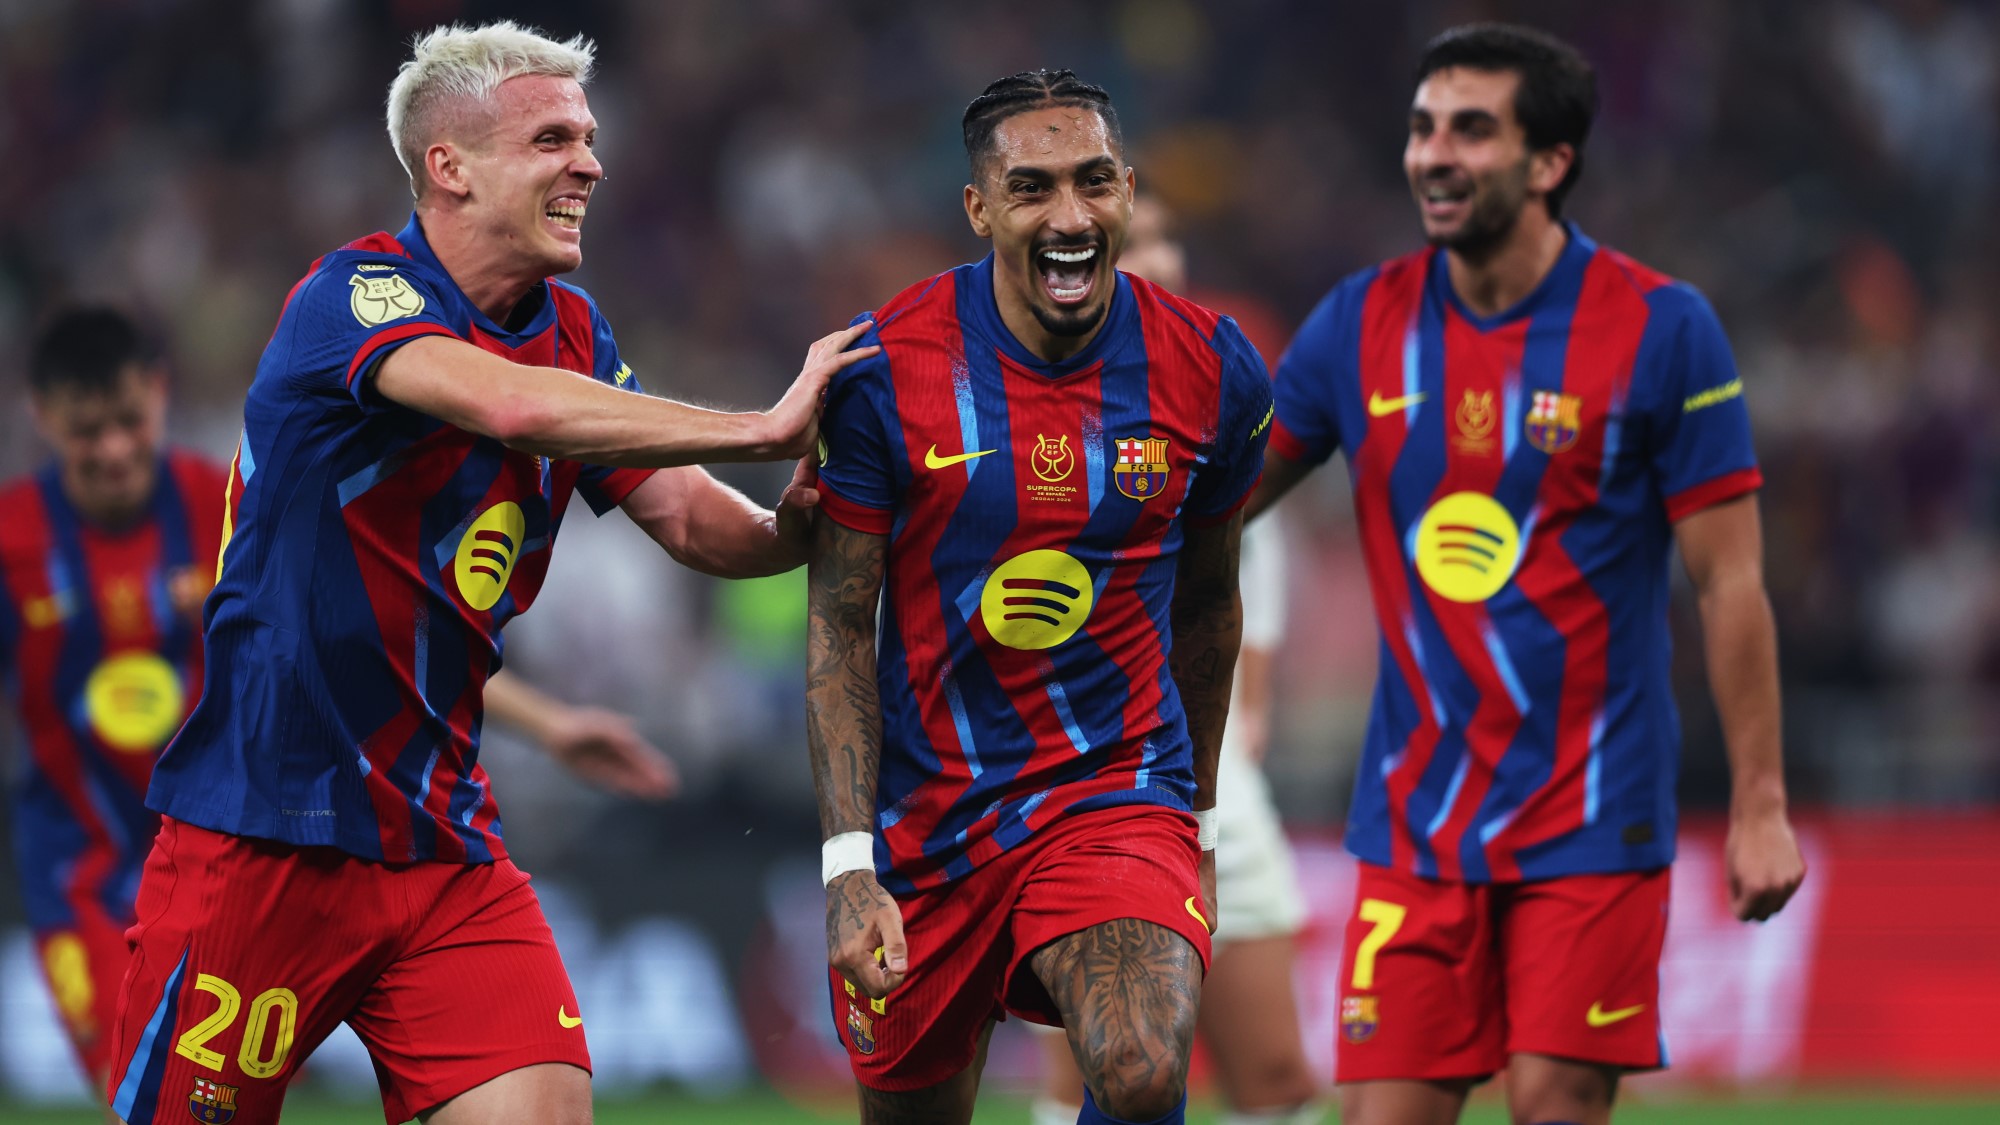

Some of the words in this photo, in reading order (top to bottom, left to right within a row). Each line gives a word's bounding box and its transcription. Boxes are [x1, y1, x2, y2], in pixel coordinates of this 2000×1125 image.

[1026, 485, 1077, 493] SUPERCOPA
[1351, 897, 1407, 990] 7
[174, 972, 298, 1079] 20
